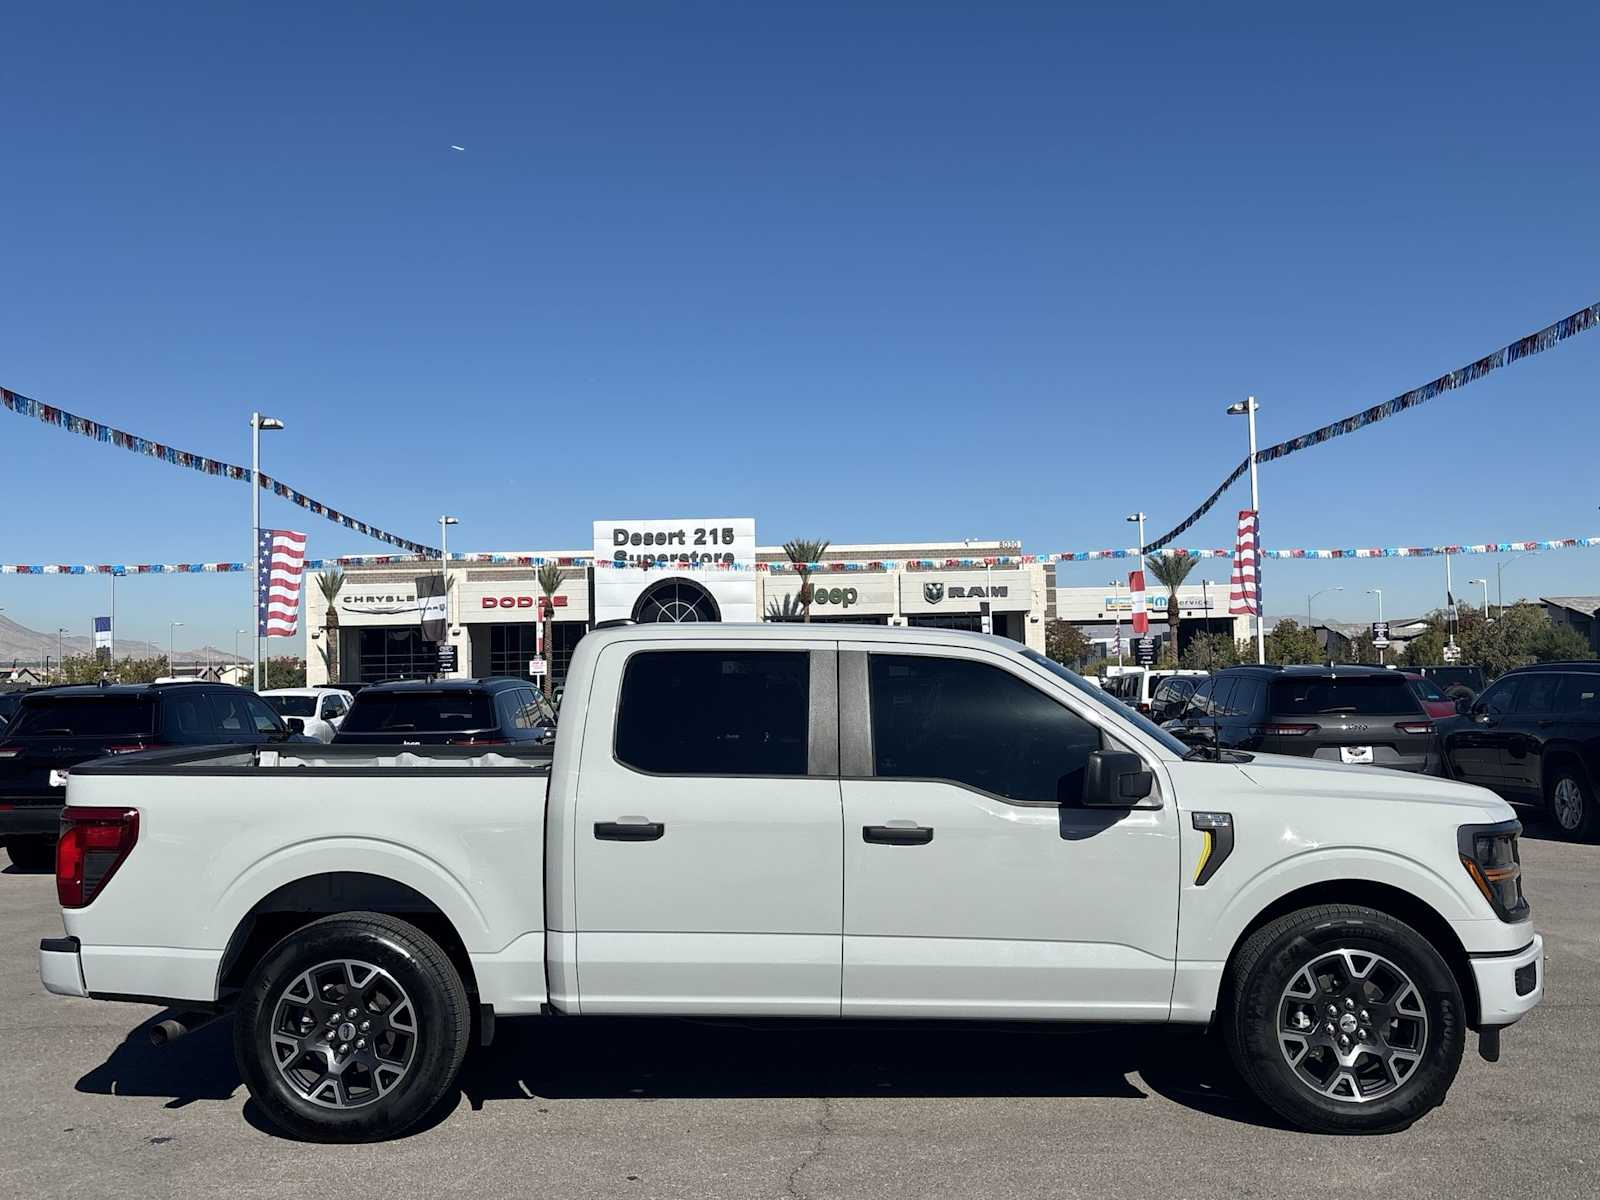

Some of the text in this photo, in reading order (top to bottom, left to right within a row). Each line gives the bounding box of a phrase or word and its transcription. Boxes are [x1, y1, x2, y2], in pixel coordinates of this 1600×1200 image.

[613, 527, 735, 546] Desert 215
[948, 586, 1008, 598] RAM
[343, 595, 415, 603] CHRYSLE
